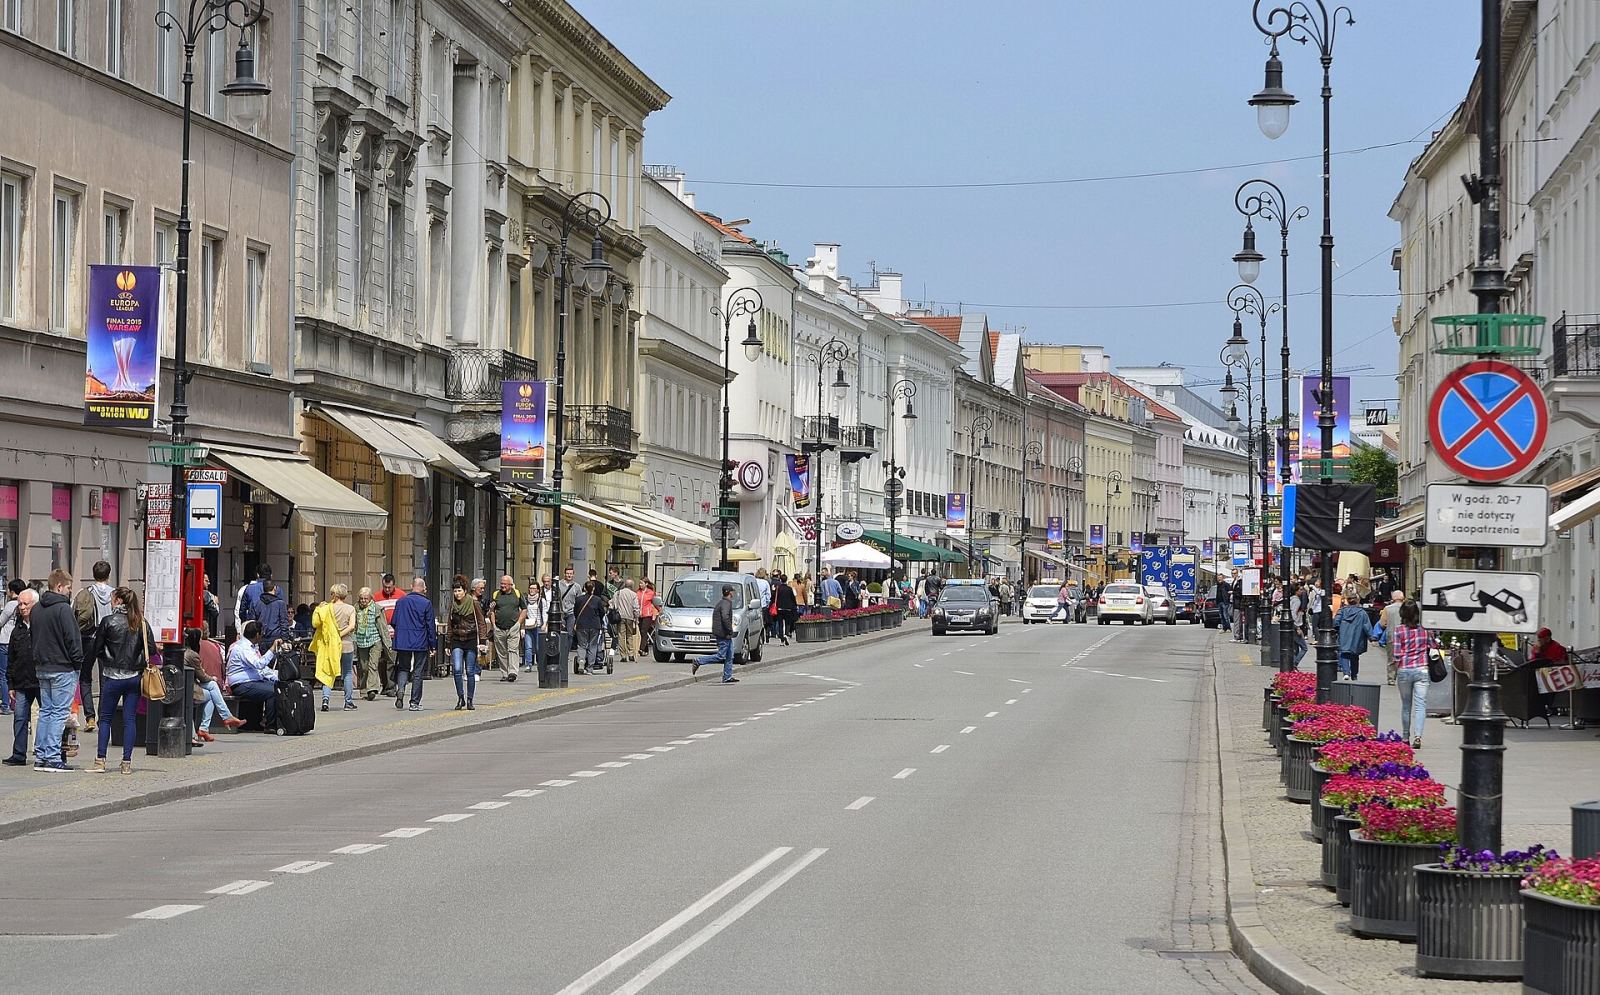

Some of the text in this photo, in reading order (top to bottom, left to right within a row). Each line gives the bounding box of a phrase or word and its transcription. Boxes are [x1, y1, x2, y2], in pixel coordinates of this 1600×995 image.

[118, 292, 133, 300] UEFA
[110, 300, 140, 308] EUROPA
[106, 324, 142, 332] WARSAW
[1367, 410, 1387, 424] H&M
[189, 470, 227, 480] FOKSAL 01
[1452, 494, 1462, 503] W
[1465, 494, 1493, 505] godz.
[1458, 510, 1515, 522] nie dotyczy
[1452, 524, 1520, 536] zaopatrzenia
